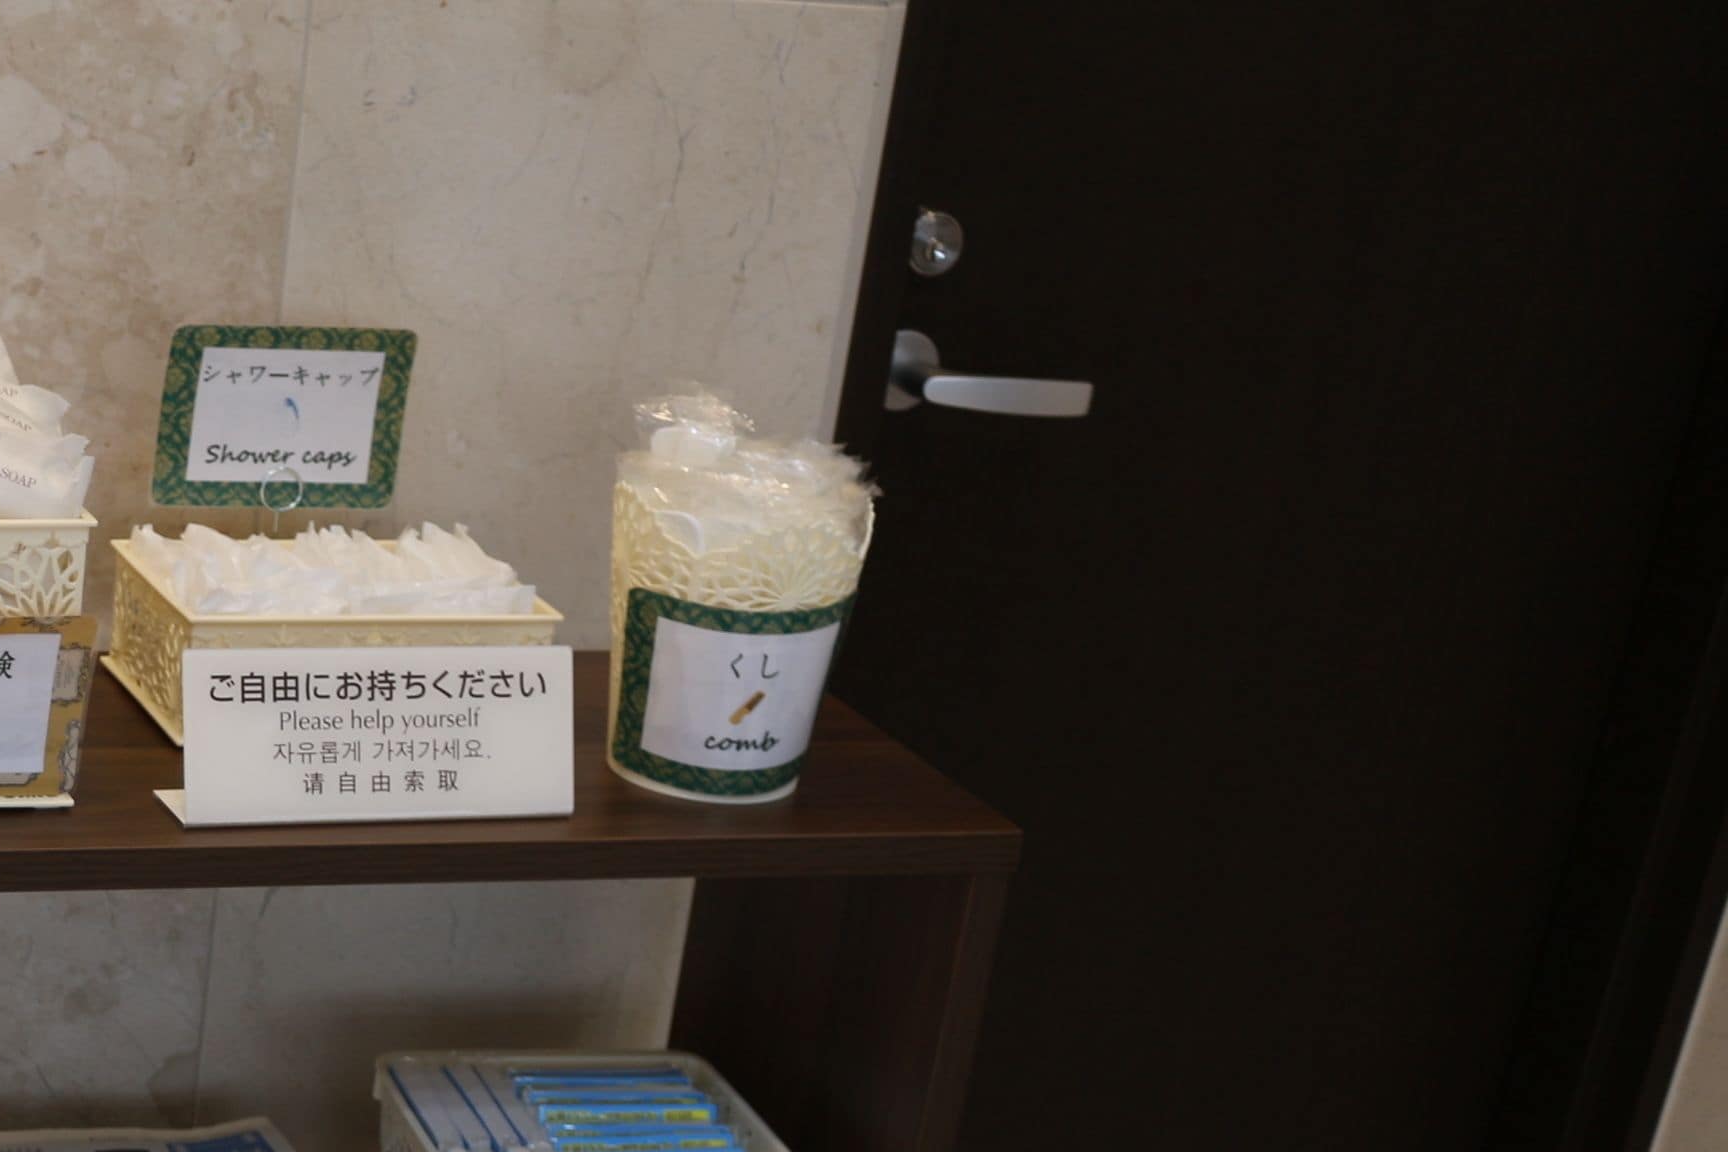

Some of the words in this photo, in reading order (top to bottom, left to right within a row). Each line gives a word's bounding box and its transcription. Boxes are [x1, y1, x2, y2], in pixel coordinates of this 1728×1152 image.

[202, 365, 380, 387] シャワーキャップ
[0, 411, 32, 432] SOAP
[205, 444, 295, 465] Shower
[301, 449, 357, 470] caps
[0, 468, 37, 489] SOAP
[730, 653, 779, 680] くし
[209, 669, 547, 705] ご自由にお持ちください
[279, 709, 344, 731] Please
[350, 708, 395, 736] help
[401, 706, 482, 734] yourself
[273, 740, 362, 765] 자유롭게
[372, 738, 492, 762] 가져가세요.
[703, 731, 780, 753] comb
[302, 769, 460, 795] 请自由索取
